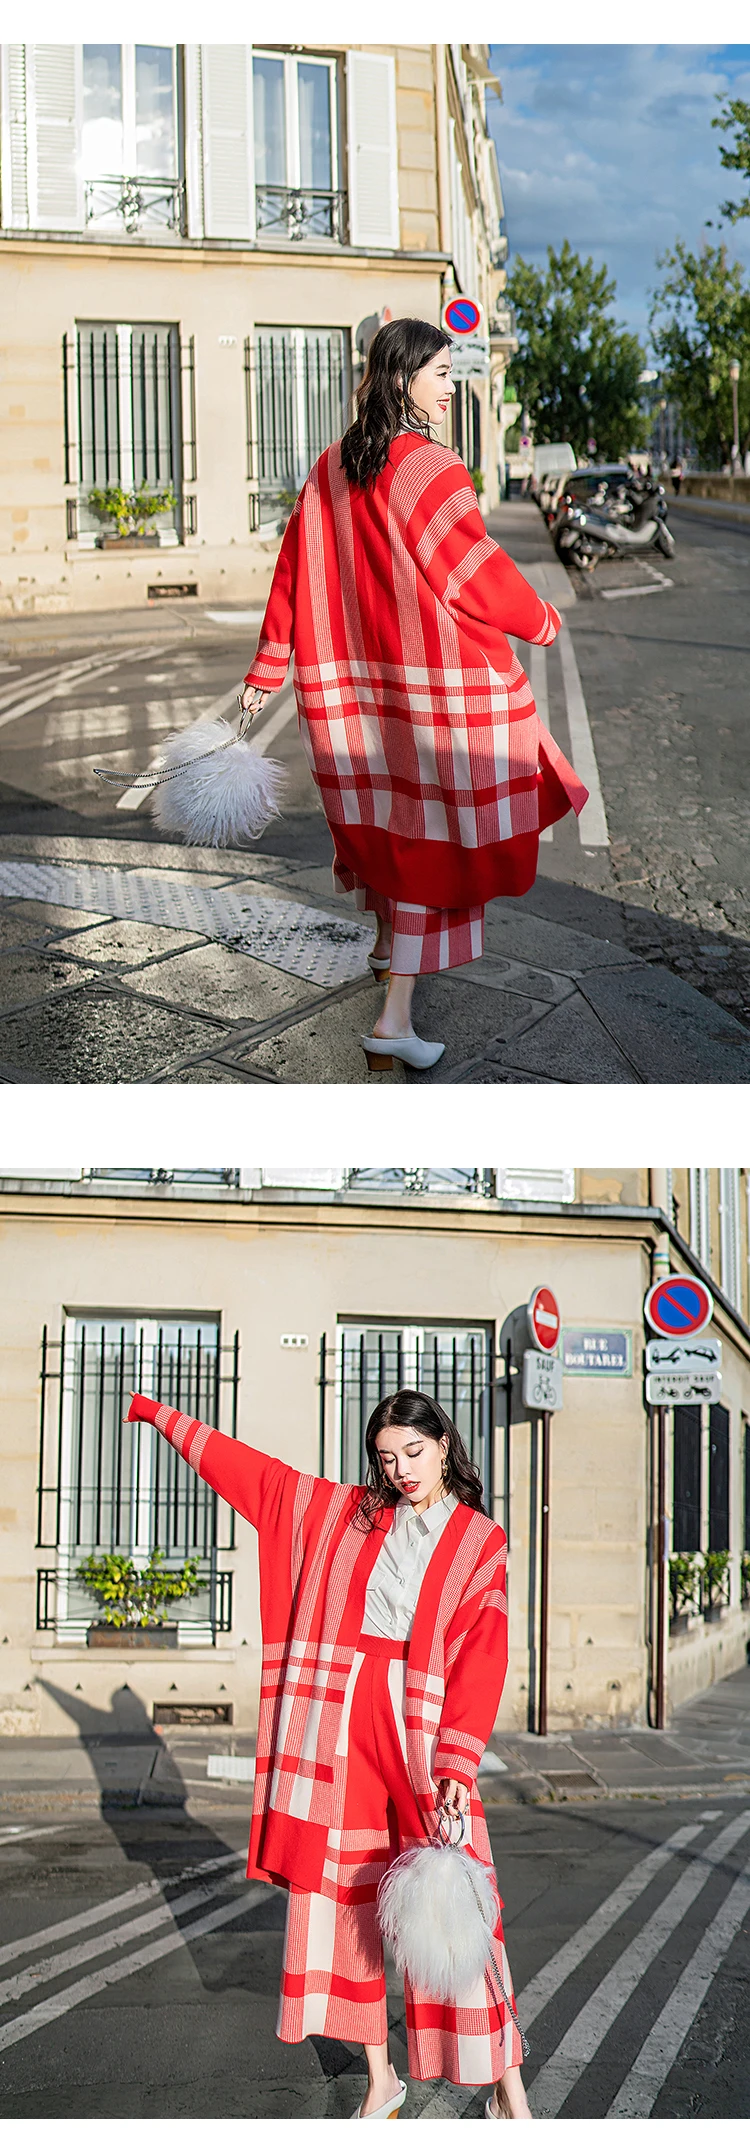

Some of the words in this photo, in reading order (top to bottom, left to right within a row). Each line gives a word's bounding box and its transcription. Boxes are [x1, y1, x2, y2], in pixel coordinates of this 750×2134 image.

[583, 1337, 608, 1352] RUE
[536, 1356, 554, 1372] SAUF
[564, 1352, 624, 1367] BOUTAREL
